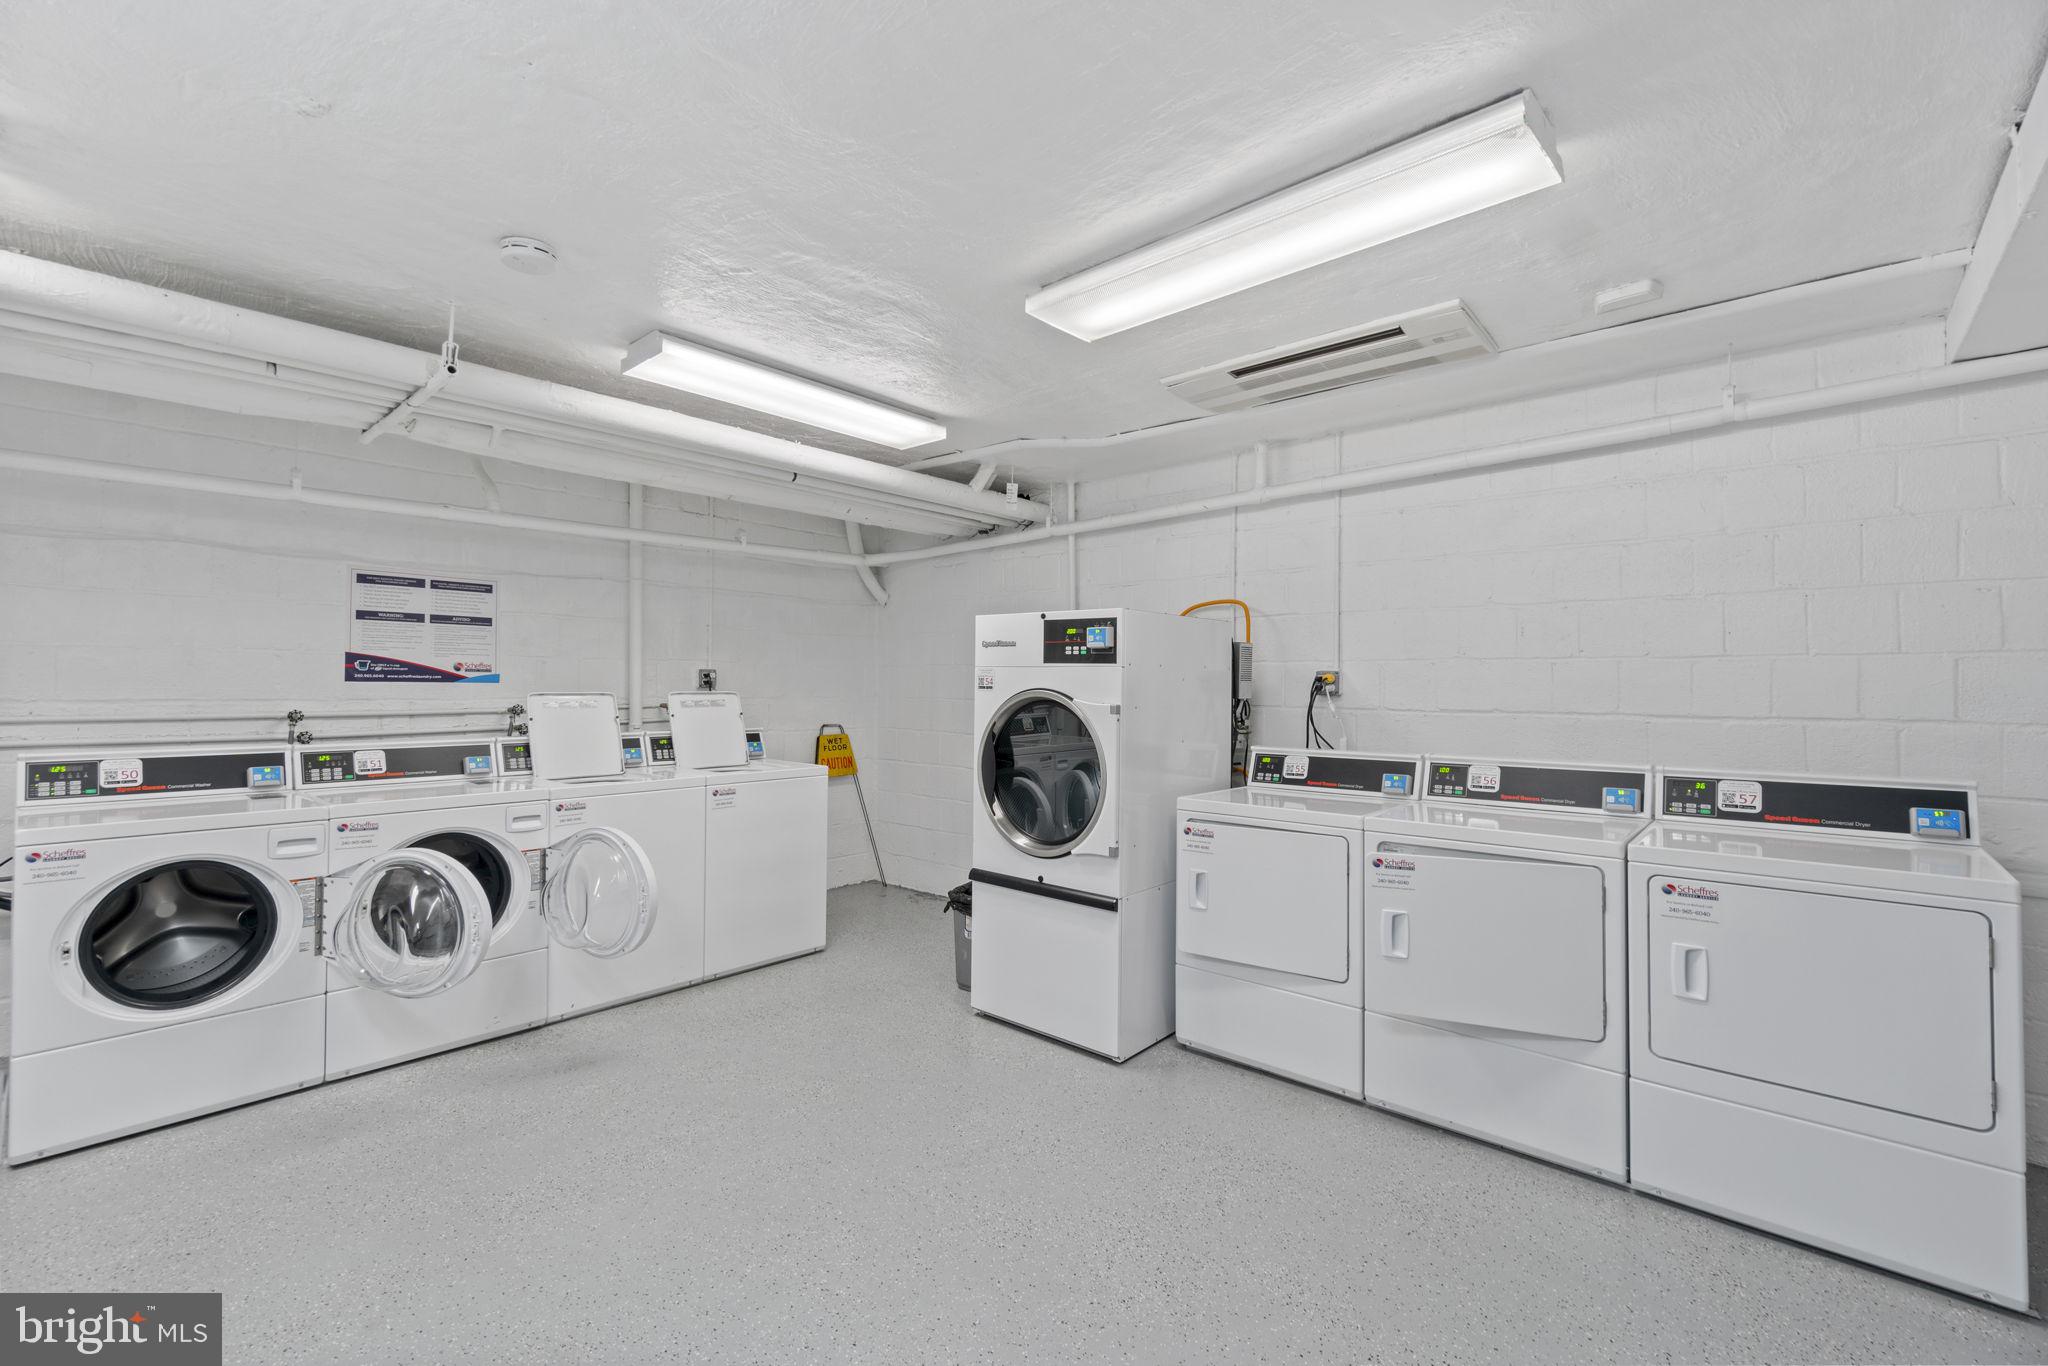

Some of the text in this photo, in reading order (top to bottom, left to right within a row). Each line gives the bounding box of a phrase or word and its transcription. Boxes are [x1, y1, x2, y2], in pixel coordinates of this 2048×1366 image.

[826, 737, 843, 745] WET
[823, 744, 848, 752] FLOOR
[369, 759, 383, 769] 51
[1295, 765, 1306, 773] 55
[121, 769, 139, 780] 50
[1483, 776, 1497, 785] 56
[1739, 793, 1757, 805] 57
[1820, 819, 1855, 827] Commercial
[42, 848, 87, 860] Scheffres
[1384, 858, 1416, 867] Scheffres
[1677, 885, 1719, 897] Scheffres
